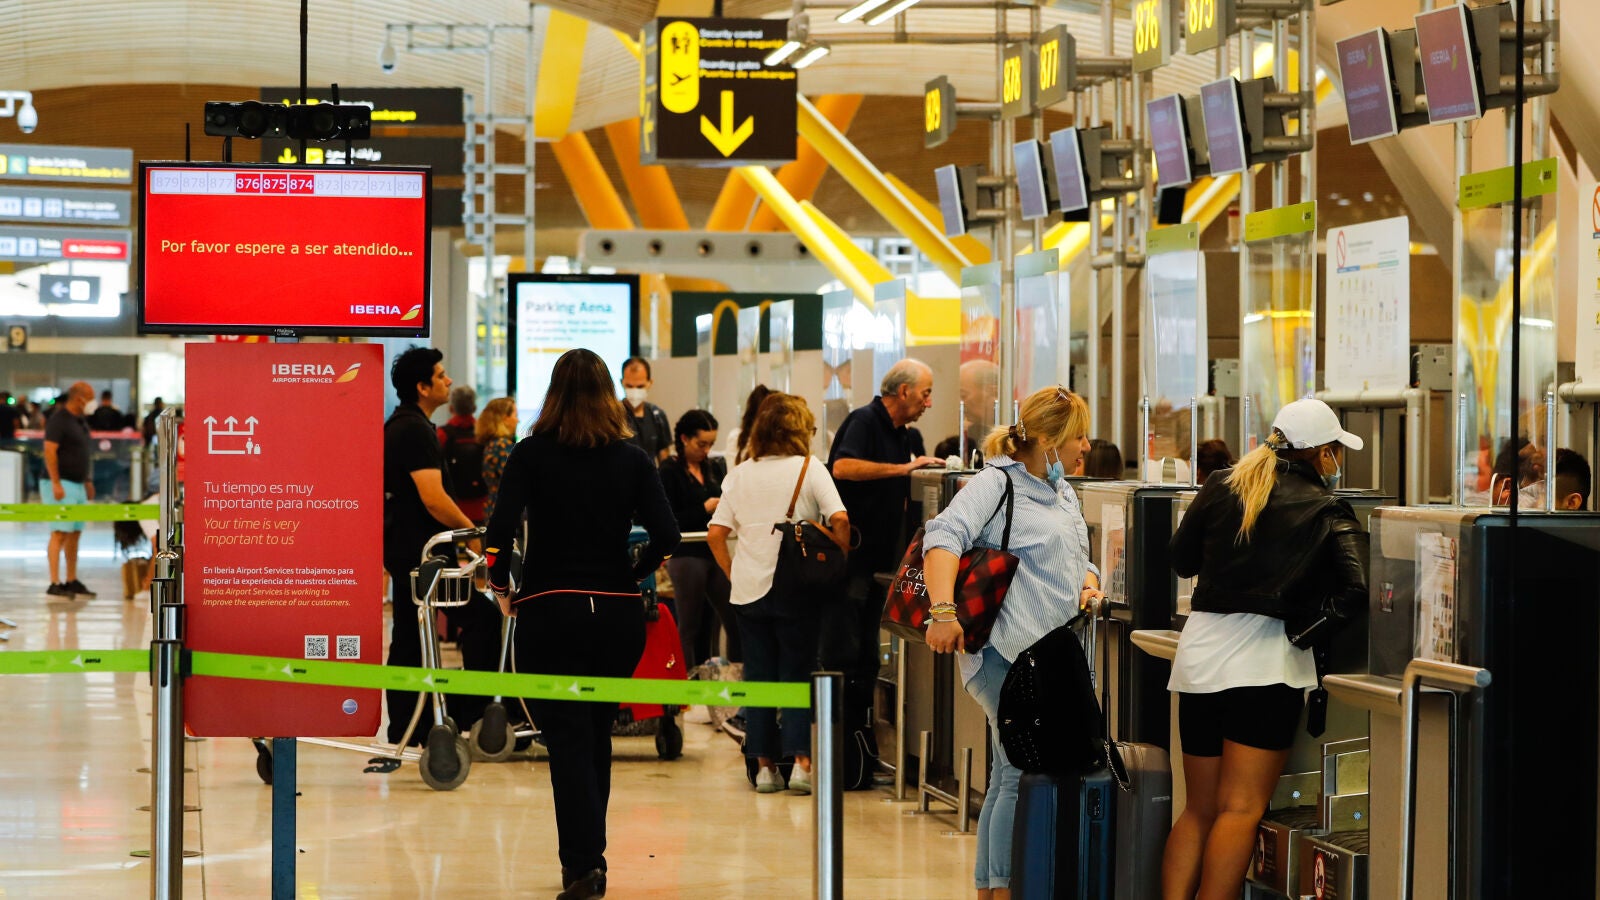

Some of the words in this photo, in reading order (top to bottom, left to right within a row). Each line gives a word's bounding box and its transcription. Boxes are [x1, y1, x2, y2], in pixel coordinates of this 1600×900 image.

[1189, 0, 1214, 34] 875
[1135, 0, 1159, 54] 876
[1039, 39, 1059, 91] 877
[1003, 55, 1022, 104] 878
[925, 88, 942, 133] 879
[155, 176, 180, 189] 879
[182, 177, 207, 190] 878
[209, 177, 233, 190] 877
[236, 178, 261, 190] 876
[263, 178, 287, 190] 875
[290, 178, 314, 191] 874
[316, 179, 341, 191] 873
[343, 179, 368, 191] 872
[370, 179, 393, 192] 871
[397, 180, 421, 192] 870
[161, 240, 187, 252] Por
[191, 240, 230, 253] favor
[235, 243, 285, 256] espere
[291, 244, 300, 254] a
[305, 244, 329, 254] ser
[333, 243, 414, 256] atendido...
[350, 304, 401, 315] IBERIA
[272, 364, 336, 376] IBERIA
[203, 481, 220, 493] Tu
[222, 482, 266, 496] tiempo
[269, 484, 283, 493] es
[286, 484, 314, 496] muy
[203, 497, 273, 511] importante
[276, 499, 303, 511] para
[306, 498, 359, 509] nosotros
[203, 518, 231, 530] Your
[233, 518, 261, 530] time
[262, 518, 271, 530] is
[273, 520, 300, 532] very
[203, 534, 264, 547] important
[266, 534, 279, 545] to
[281, 536, 295, 545] us
[236, 567, 262, 576] Airport
[295, 567, 336, 576] trabajamos
[337, 568, 354, 576] para
[203, 577, 231, 586] mejorar
[233, 577, 240, 585] la
[241, 577, 283, 587] experiencia
[284, 577, 294, 585] de
[327, 577, 358, 585] clientes.
[225, 588, 251, 597] Airport
[291, 588, 320, 597] working
[321, 588, 330, 596] to
[203, 599, 232, 608] improve
[248, 599, 287, 608] experience
[288, 598, 298, 606] of
[311, 599, 351, 607] customers.
